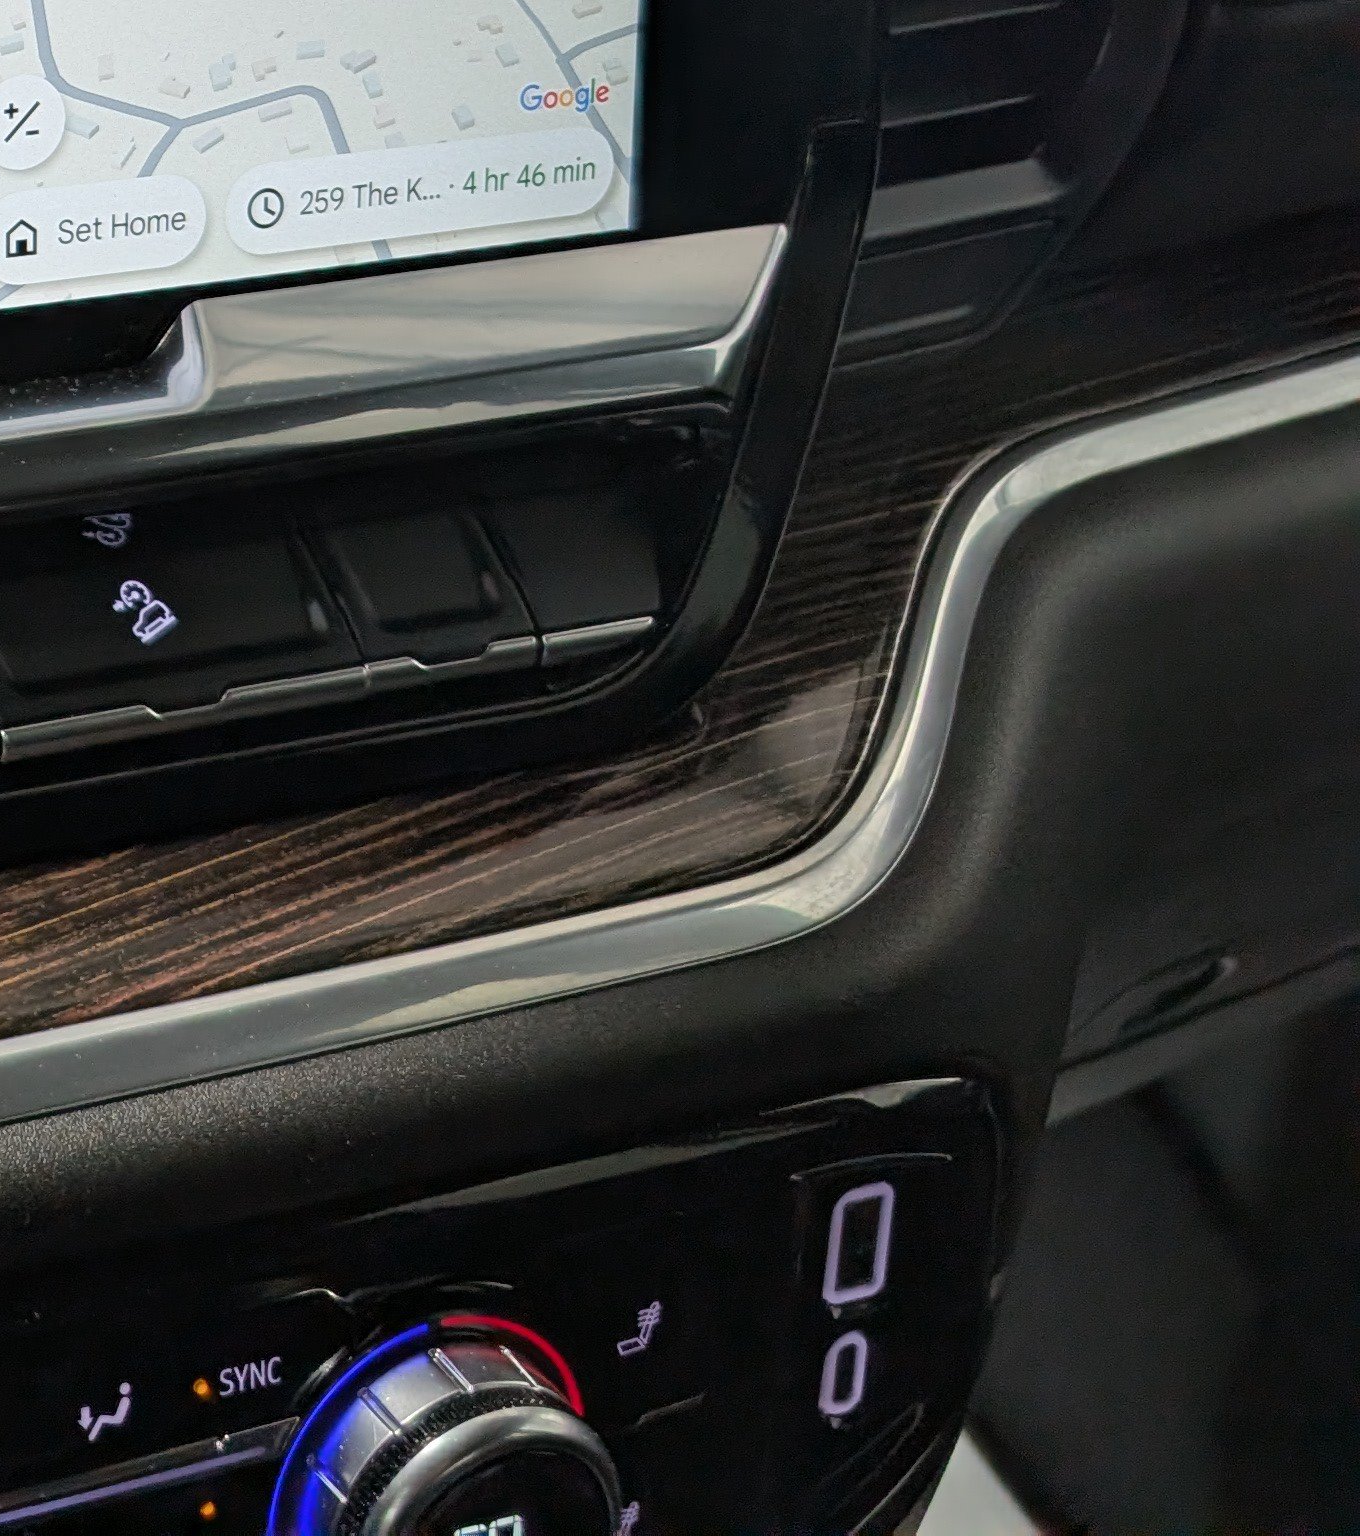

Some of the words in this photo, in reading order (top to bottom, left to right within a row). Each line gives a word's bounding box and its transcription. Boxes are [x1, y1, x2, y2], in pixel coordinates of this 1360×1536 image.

[519, 77, 611, 114] Google
[300, 186, 345, 216] 259
[351, 181, 399, 209] The
[461, 170, 478, 195] 4
[484, 167, 510, 193] hr
[515, 162, 546, 188] 46
[553, 156, 596, 184] min
[57, 217, 103, 245] Set
[111, 211, 187, 239] Home
[219, 1356, 282, 1396] SYNC
